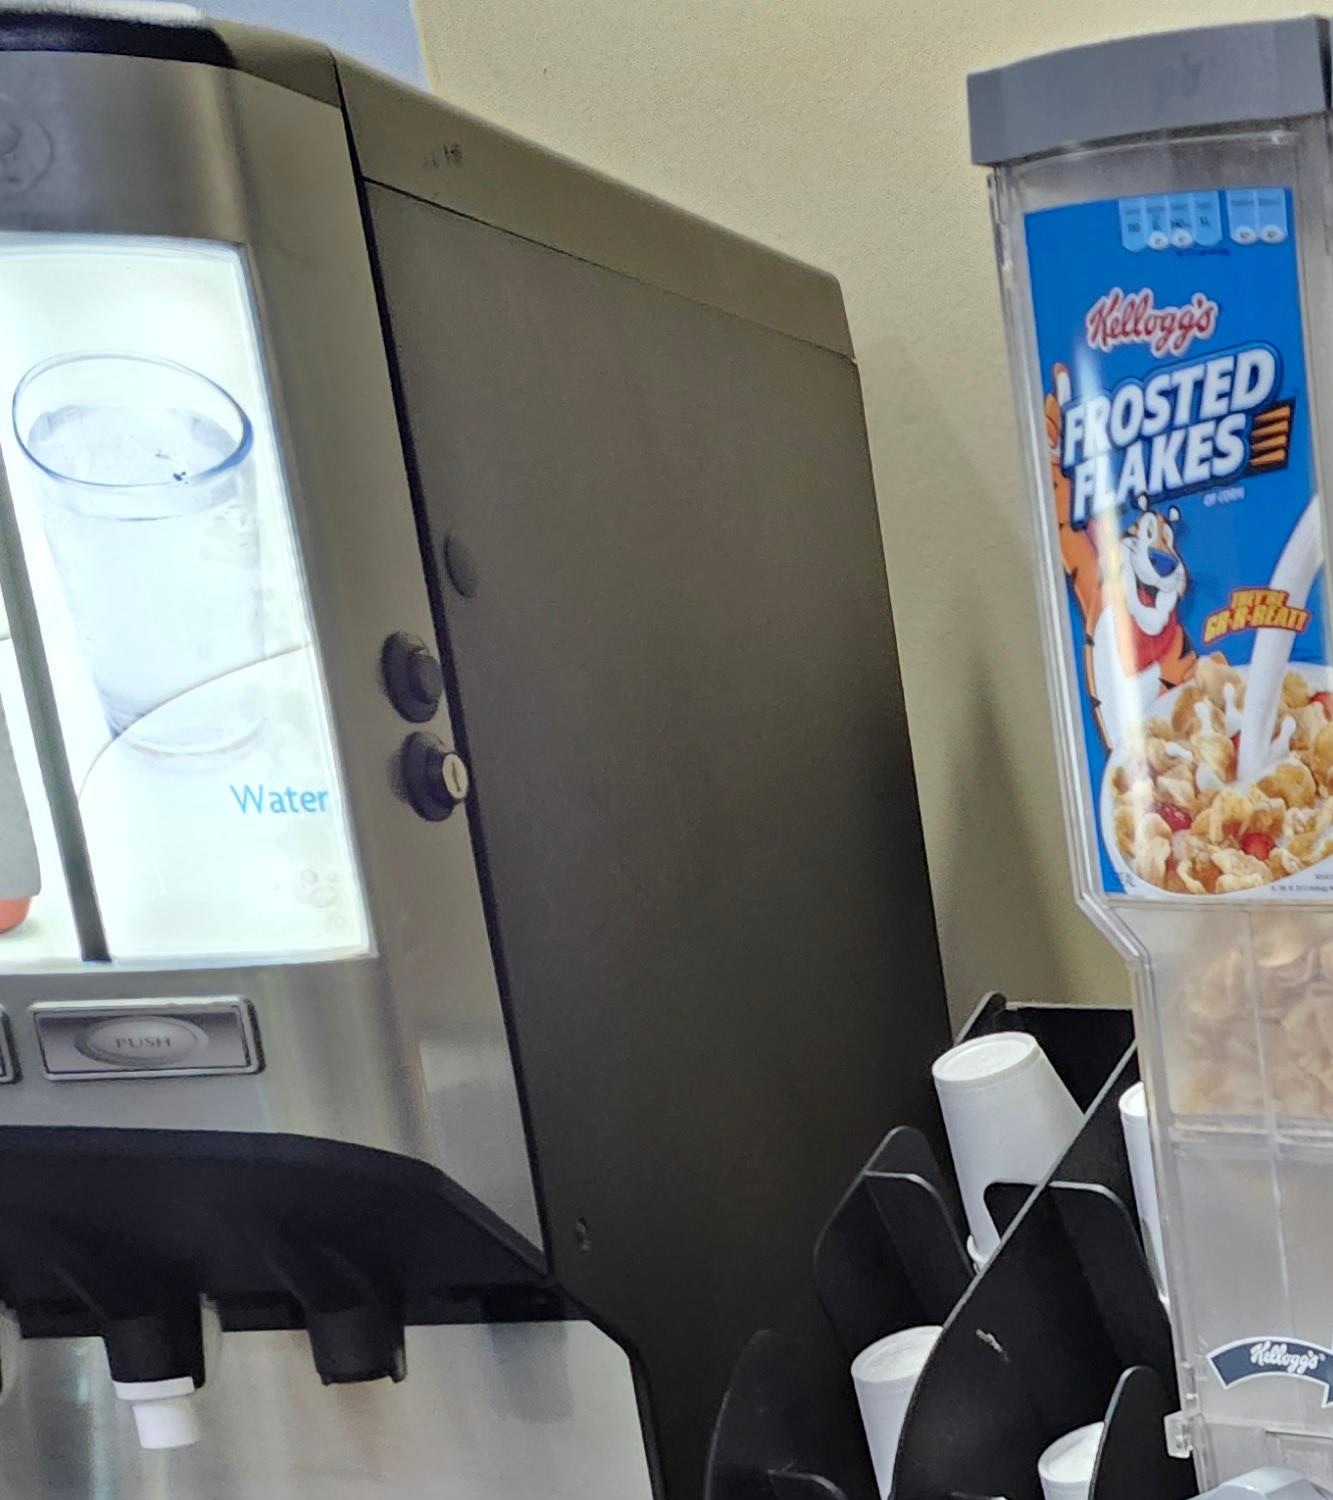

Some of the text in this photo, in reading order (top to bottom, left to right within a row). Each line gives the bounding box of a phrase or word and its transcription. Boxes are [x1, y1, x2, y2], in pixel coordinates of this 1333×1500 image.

[1088, 288, 1216, 356] Kellogg's
[1062, 347, 1276, 468] FROSTED
[1073, 412, 1247, 522] FLAKES
[230, 783, 330, 815] Water
[115, 1035, 173, 1049] PUSH
[1250, 1339, 1320, 1374] Kellogg's
